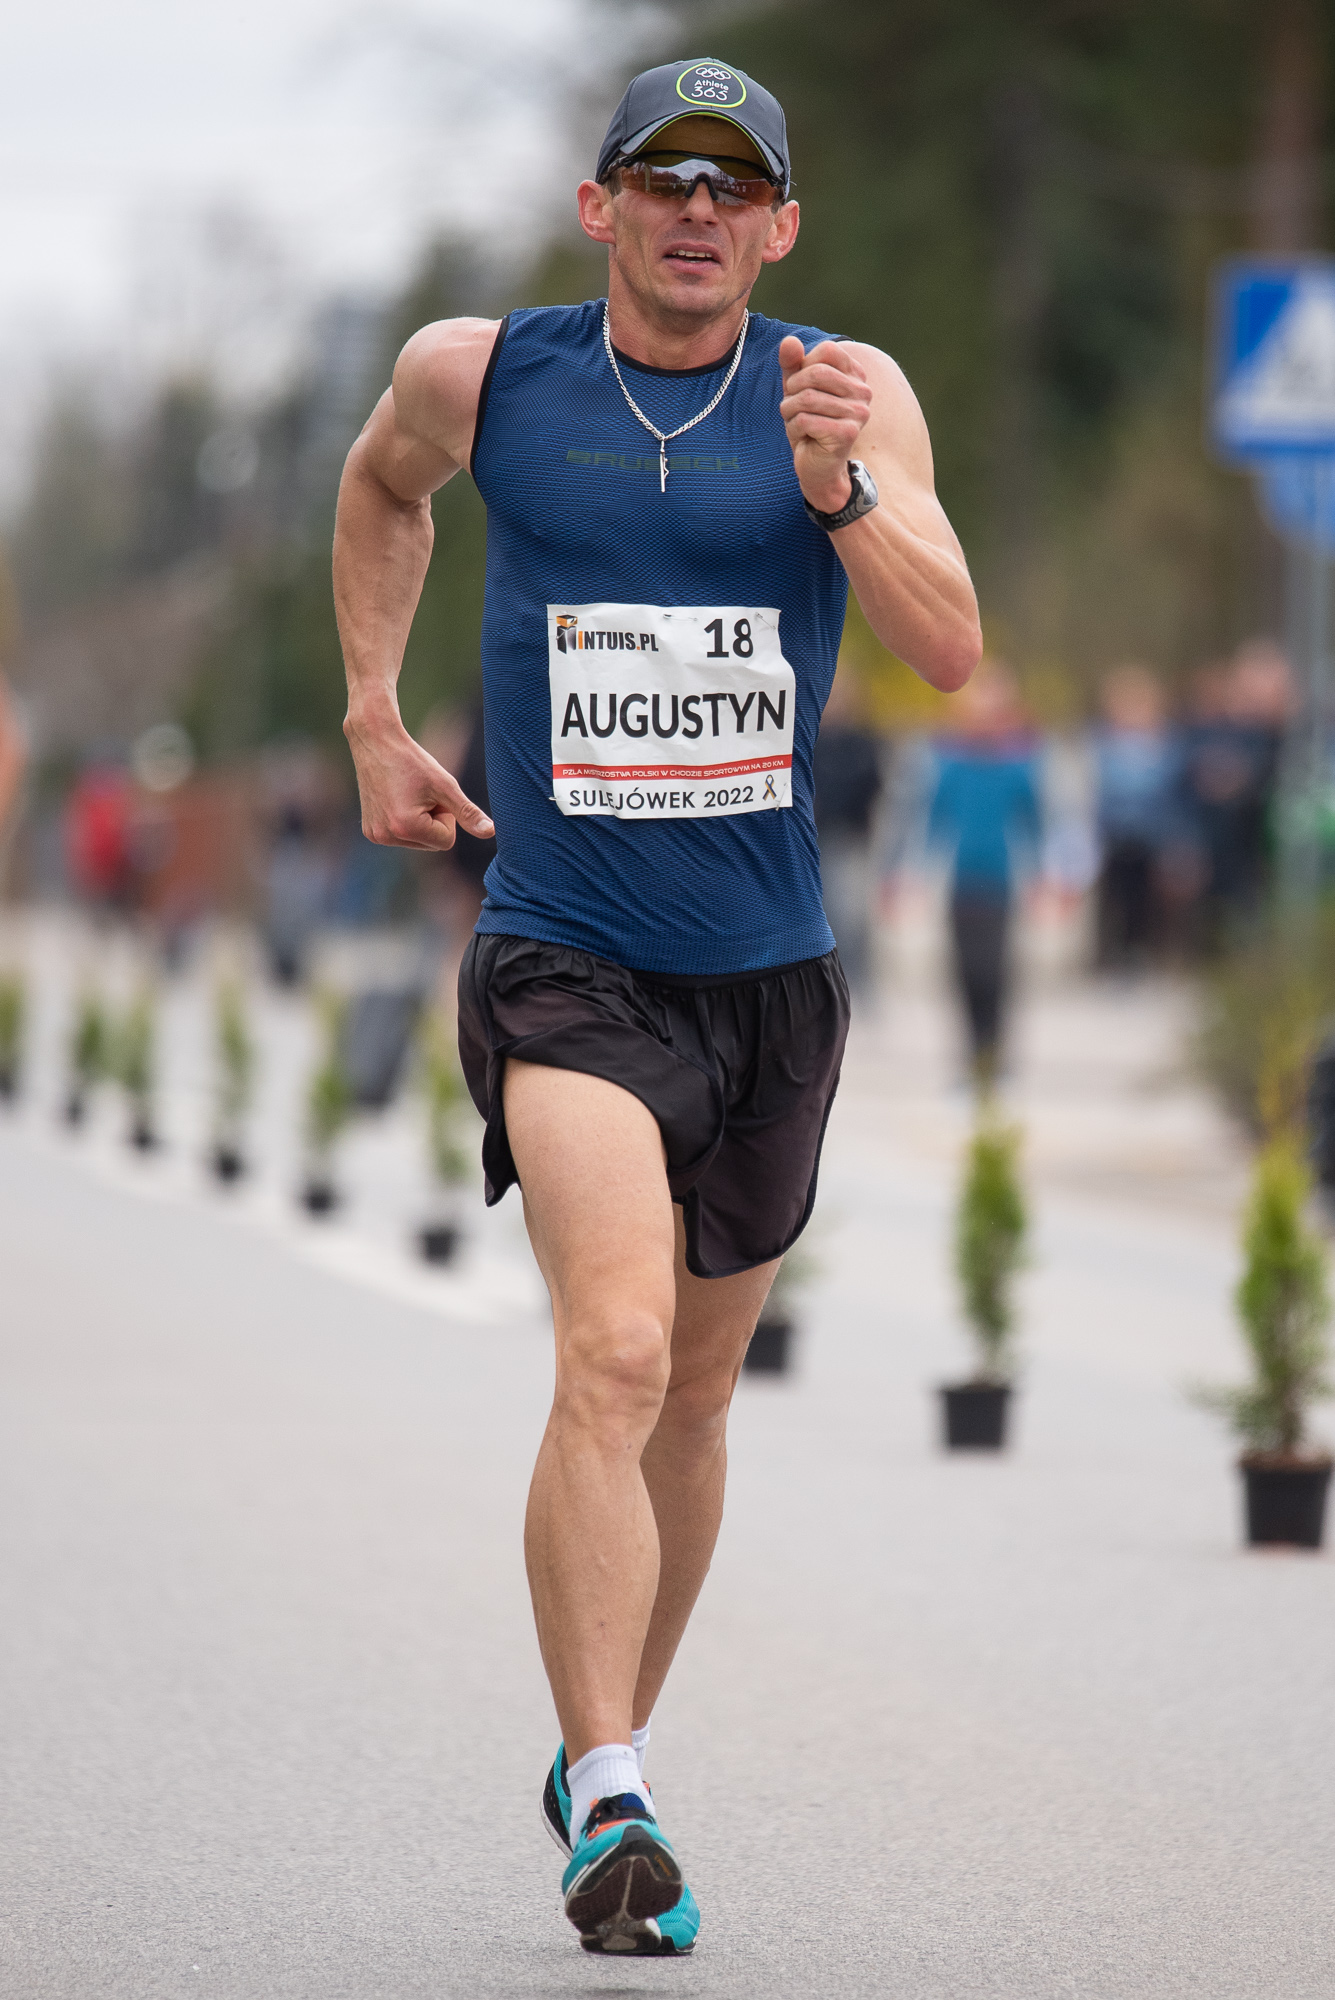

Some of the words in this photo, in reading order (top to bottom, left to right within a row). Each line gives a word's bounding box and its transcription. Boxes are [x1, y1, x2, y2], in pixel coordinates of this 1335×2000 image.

[691, 86, 728, 101] 365
[694, 80, 729, 91] Athlete
[704, 618, 754, 659] 18
[560, 689, 786, 739] AUGUSTYN
[669, 769, 703, 777] CHODZIE
[703, 765, 750, 777] SPORTOWYM
[569, 787, 695, 811] SULEJÓWEK
[703, 785, 754, 808] 2022
